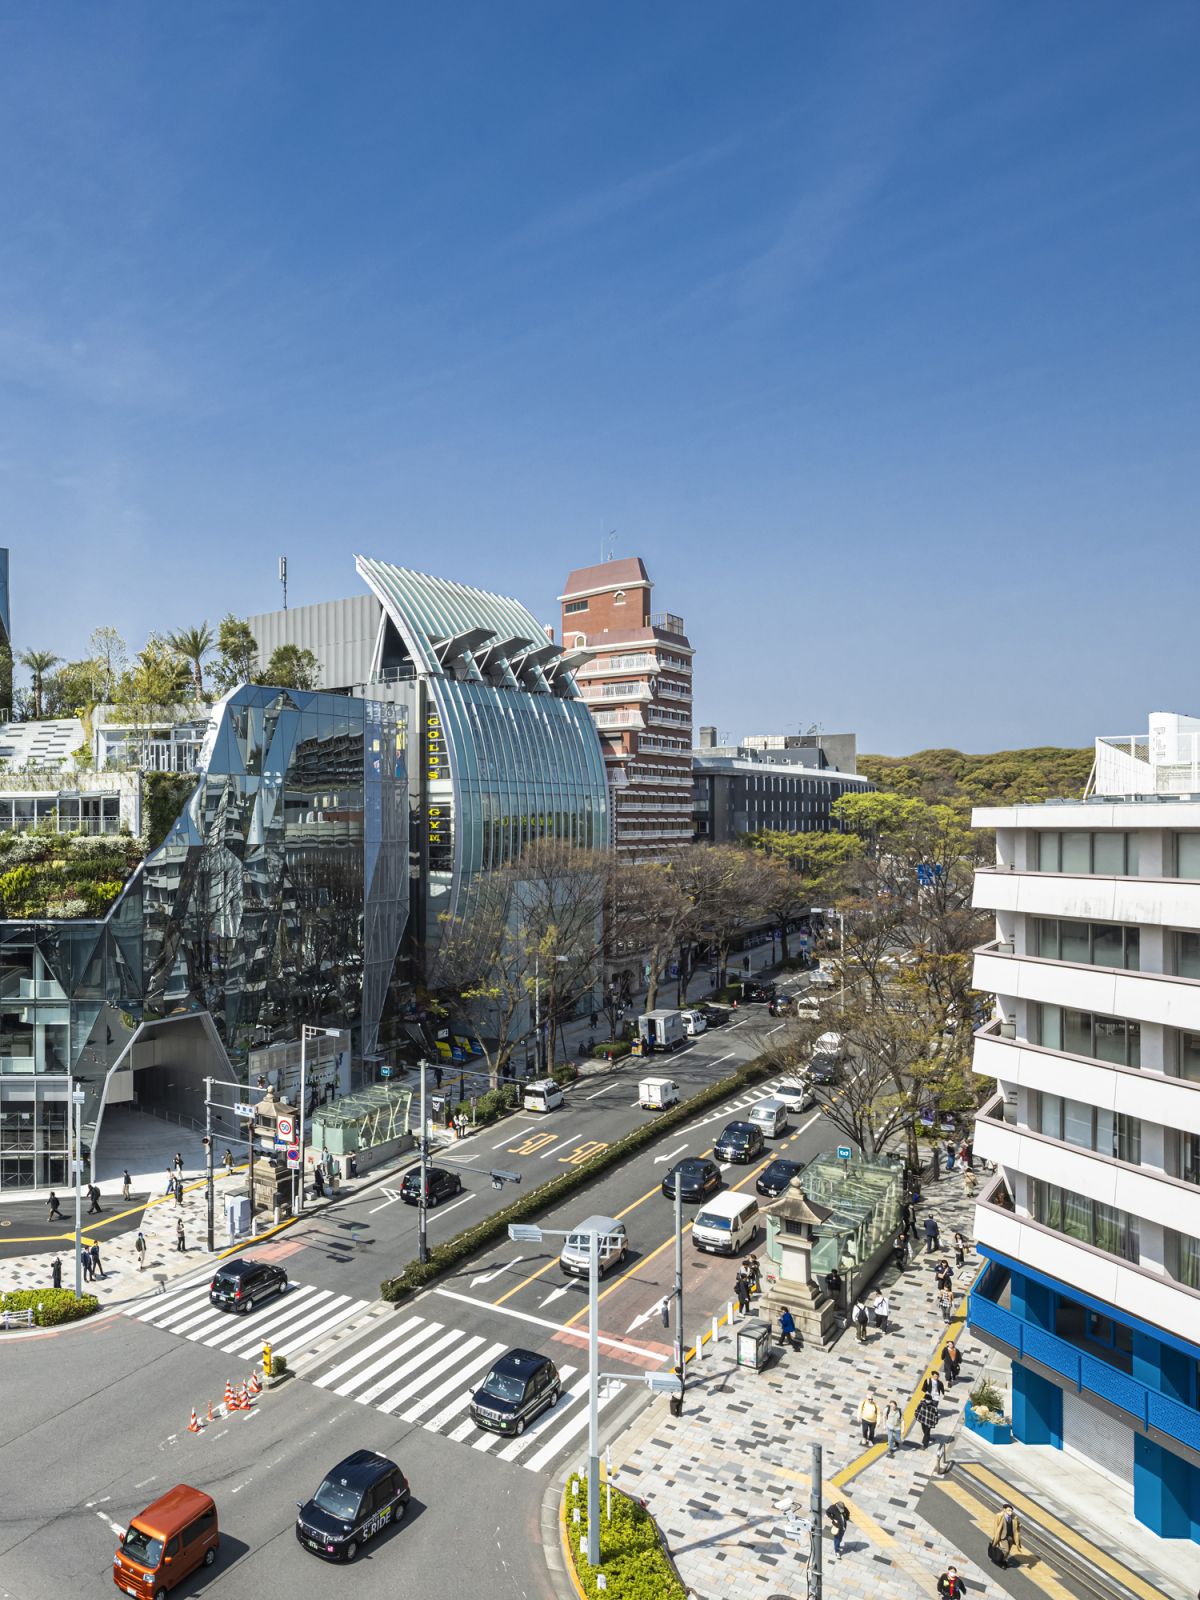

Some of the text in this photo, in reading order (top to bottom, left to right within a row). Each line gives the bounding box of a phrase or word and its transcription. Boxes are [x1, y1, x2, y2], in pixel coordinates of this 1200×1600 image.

[427, 718, 441, 780] GOLD'S
[428, 808, 441, 842] GYM
[281, 1123, 290, 1132] 50
[507, 1132, 560, 1156] 50
[557, 1140, 609, 1165] 50
